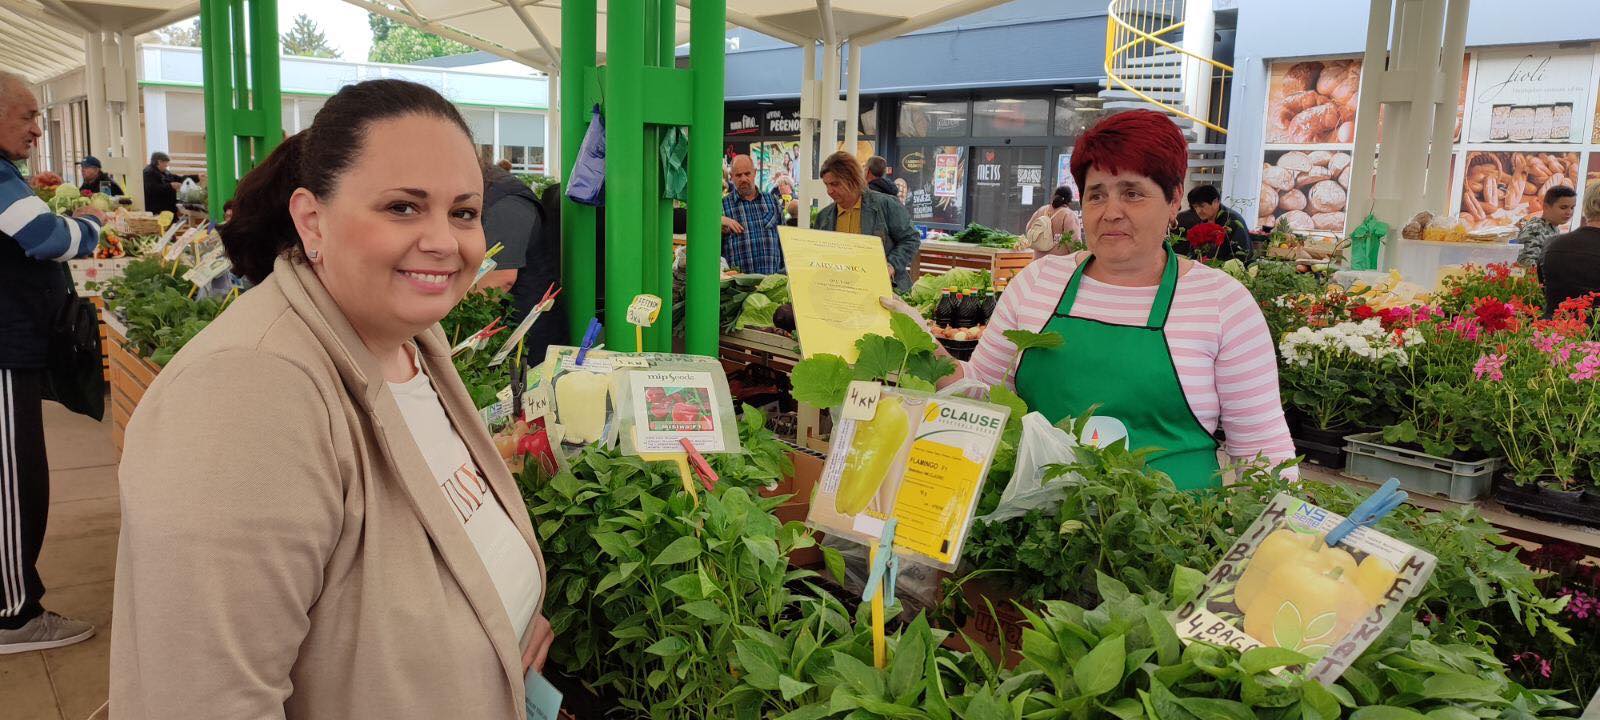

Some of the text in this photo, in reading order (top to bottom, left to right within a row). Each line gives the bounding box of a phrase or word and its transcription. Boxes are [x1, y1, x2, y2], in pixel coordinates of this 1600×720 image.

[941, 407, 1000, 429] CLAUSE
[1297, 503, 1328, 522] NS
[1312, 556, 1426, 681] MESNAT
